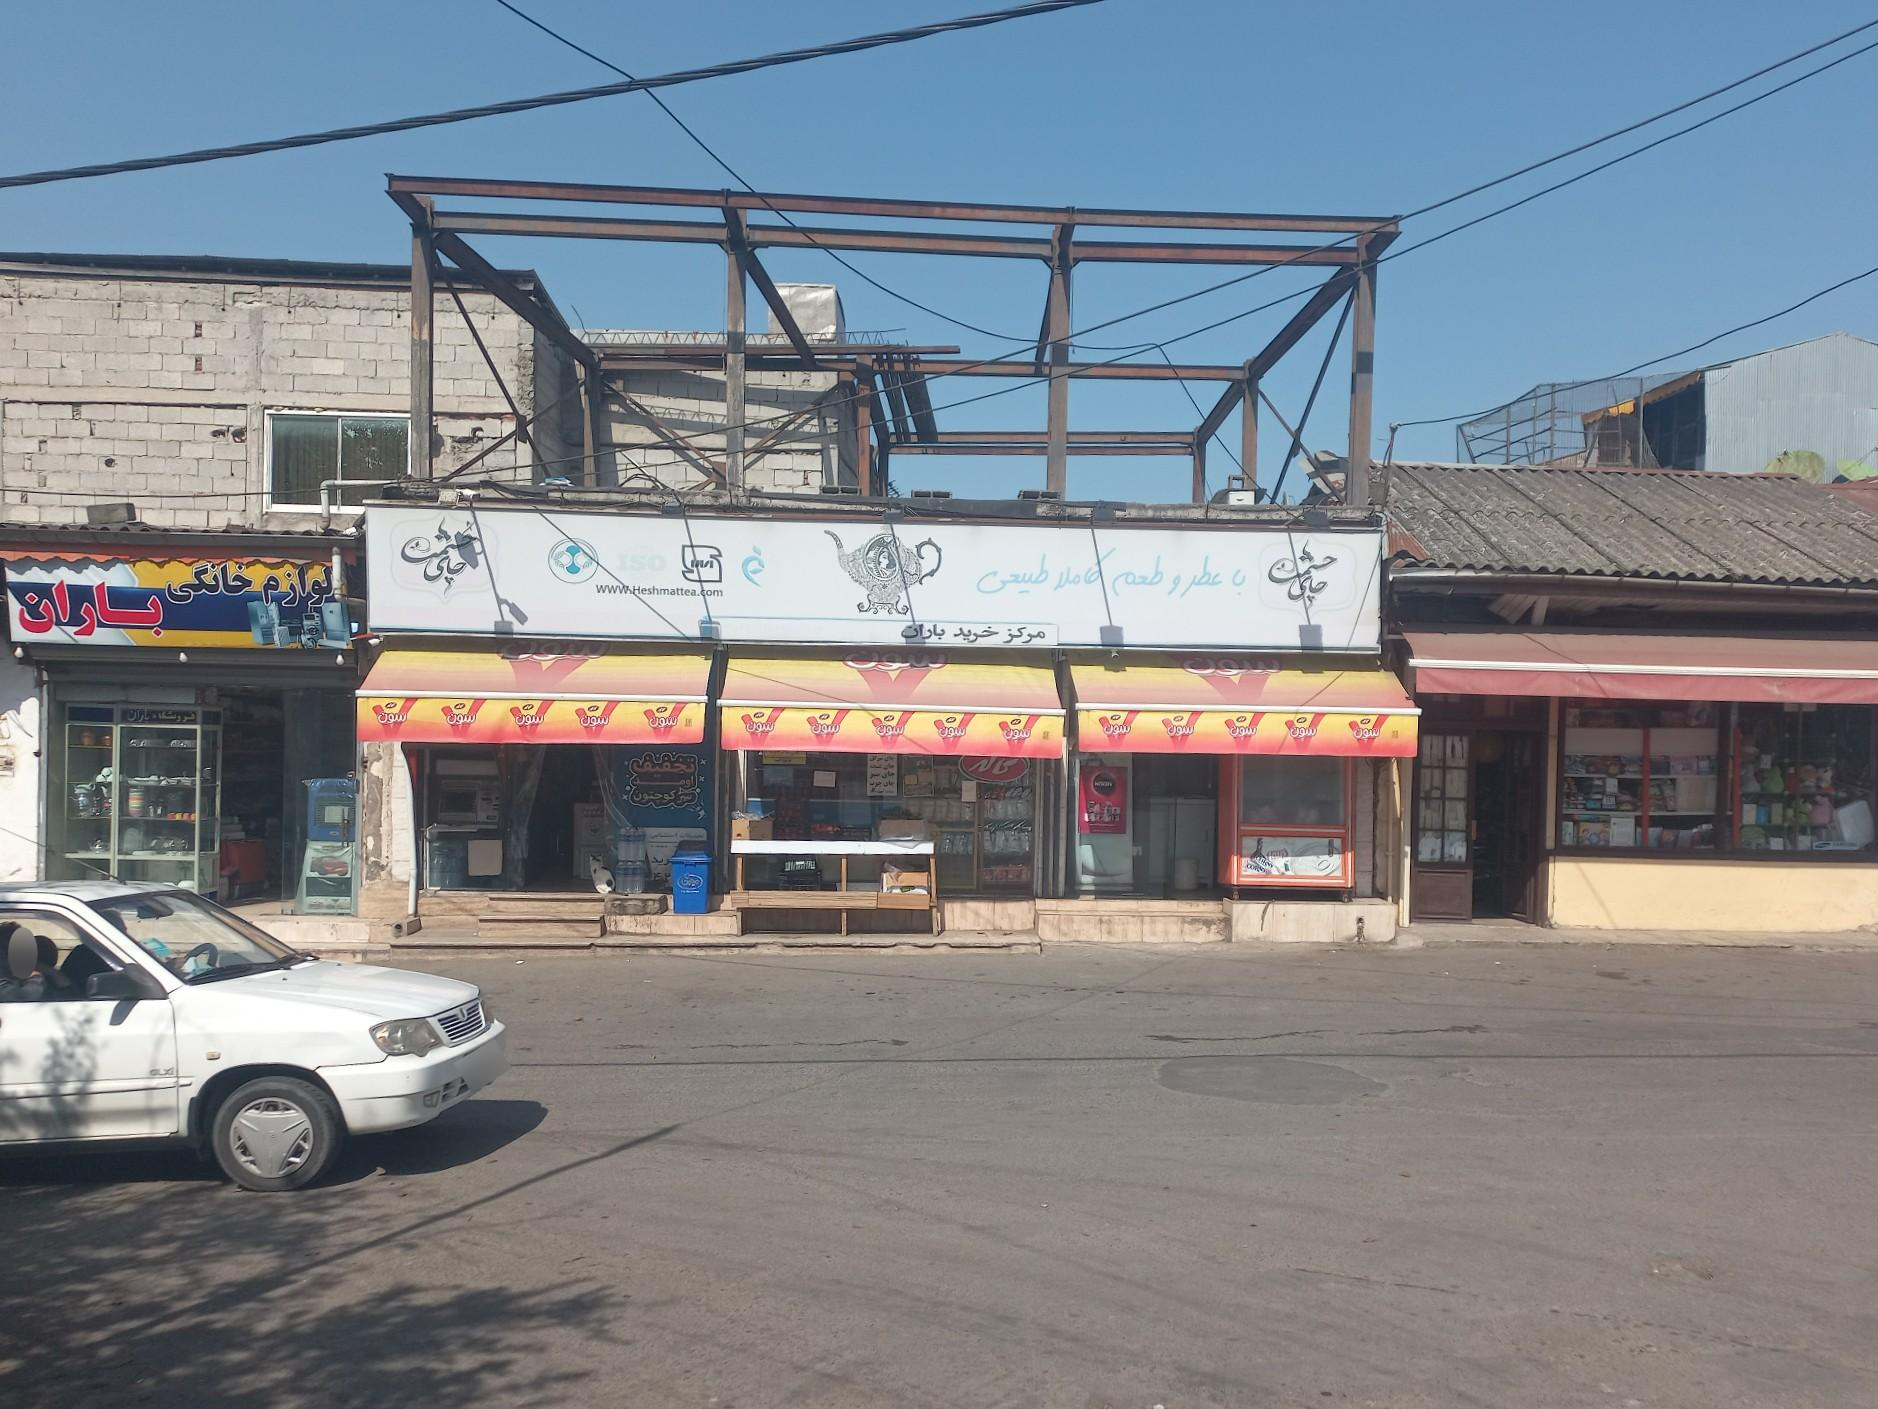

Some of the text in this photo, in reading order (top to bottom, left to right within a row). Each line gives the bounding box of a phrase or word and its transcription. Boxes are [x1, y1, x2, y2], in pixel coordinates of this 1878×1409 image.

[977, 554, 1049, 594] طبیعی
[1112, 556, 1164, 596] طعم
[1180, 555, 1223, 598] عطر
[166, 562, 335, 607] لوازم خانگی
[596, 584, 723, 598] WWW.Heshmattea.com
[1168, 575, 1179, 595] و
[18, 580, 163, 637] باران
[901, 624, 1046, 644] مرکز خرید باران
[377, 712, 408, 725] سون
[446, 712, 476, 726] سون
[515, 713, 544, 727] سون
[580, 714, 609, 728] سون
[649, 715, 678, 729] سون
[746, 721, 775, 733] سون
[811, 722, 840, 735] سون
[876, 723, 905, 737] سون
[938, 726, 966, 739] سون
[1003, 727, 1031, 740] سون
[1103, 723, 1132, 736] سون
[1167, 724, 1194, 737] سون
[1230, 725, 1257, 738] سون
[1289, 726, 1317, 739] سون
[1353, 726, 1380, 739] سون
[632, 755, 695, 777] تخفیف
